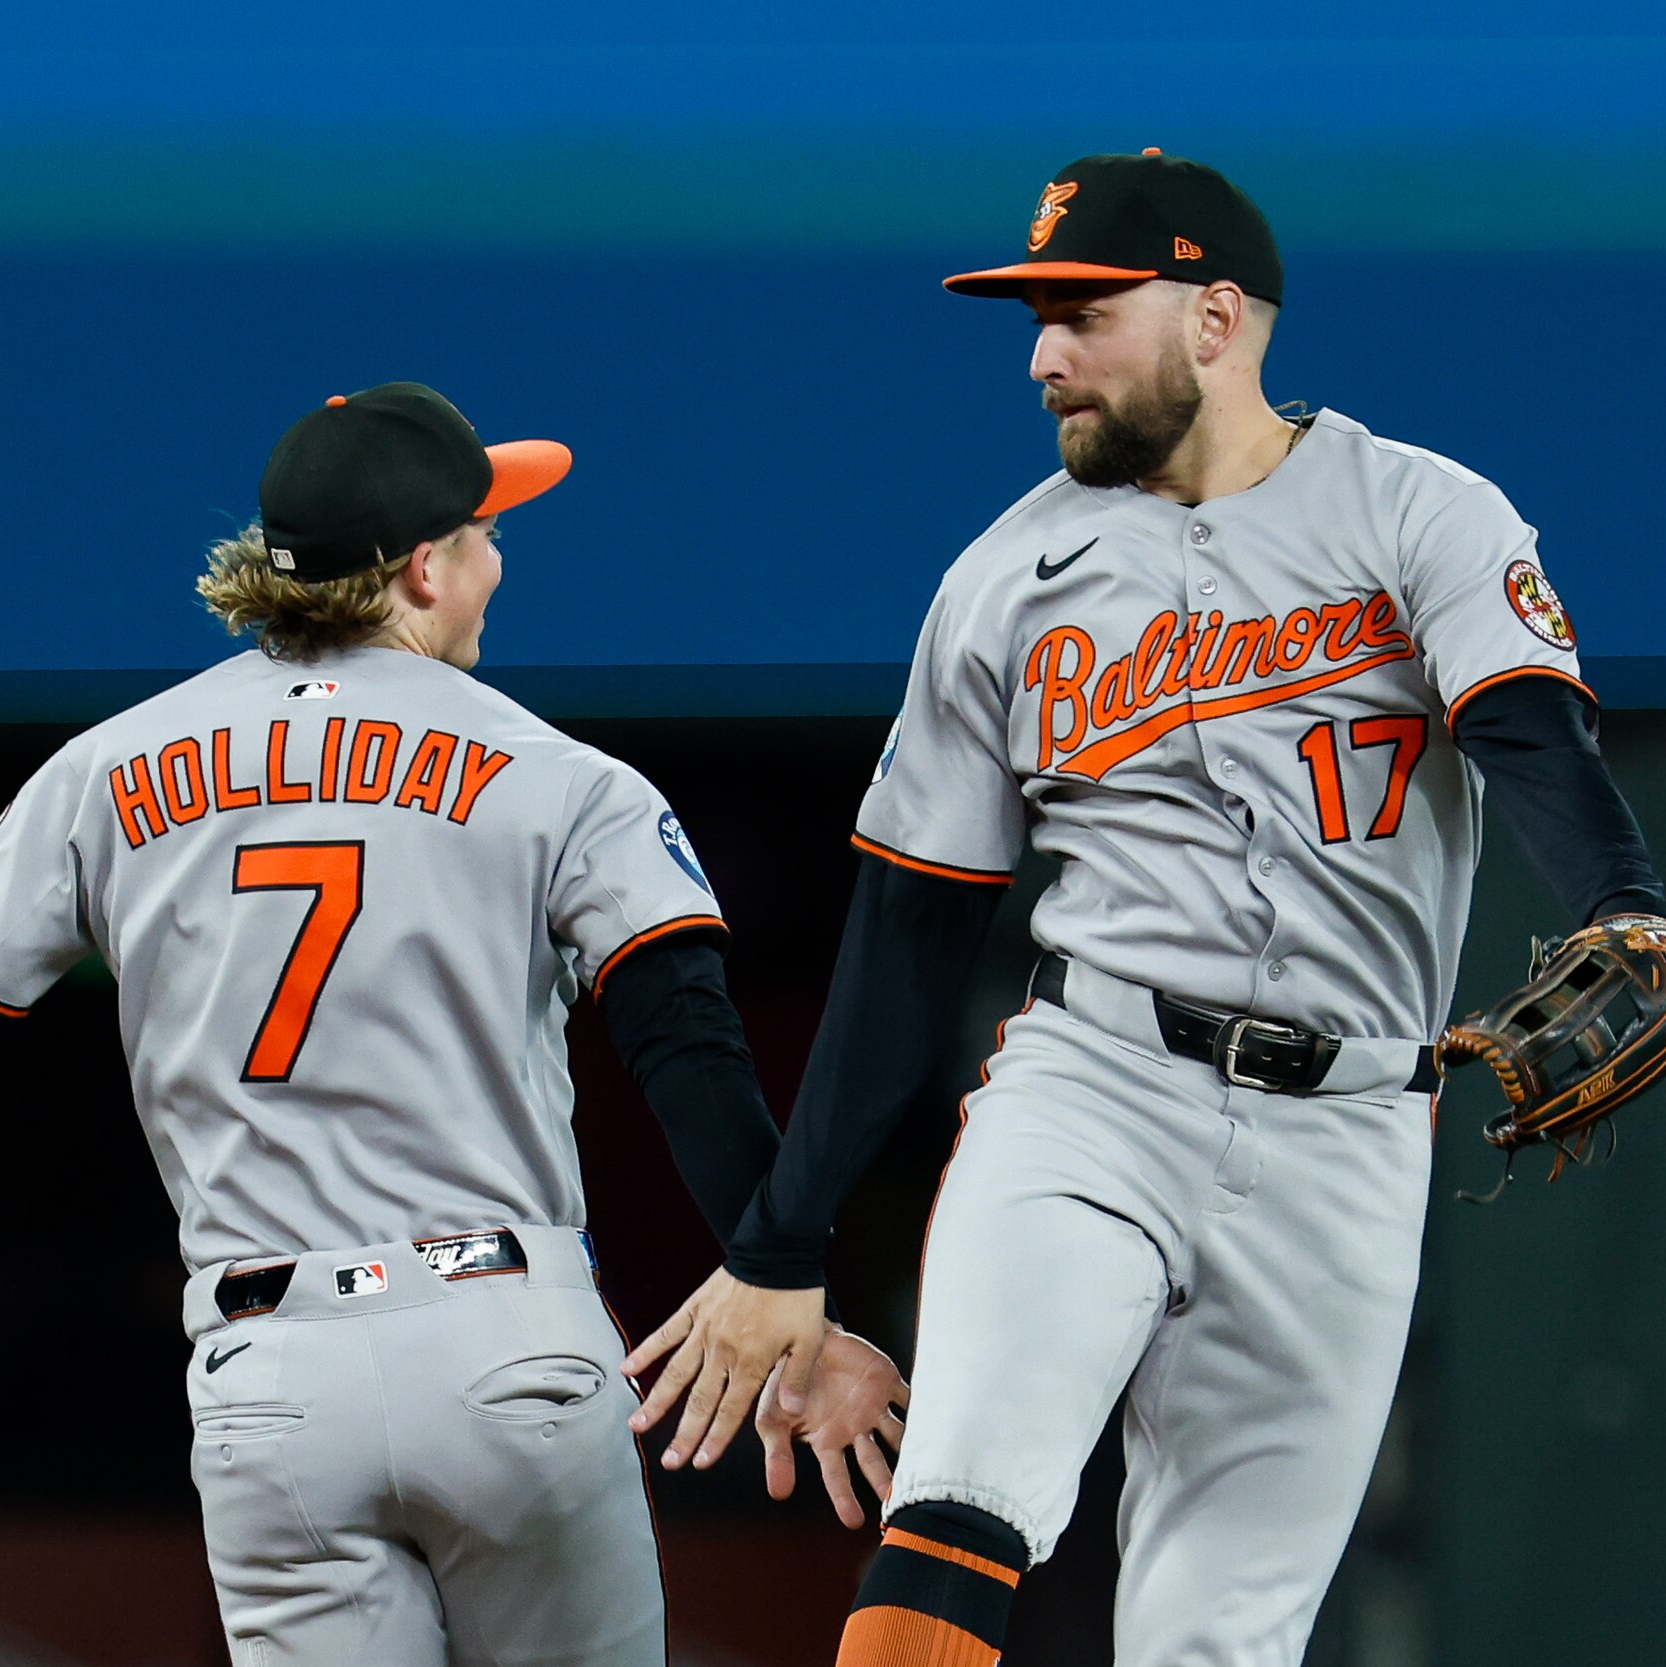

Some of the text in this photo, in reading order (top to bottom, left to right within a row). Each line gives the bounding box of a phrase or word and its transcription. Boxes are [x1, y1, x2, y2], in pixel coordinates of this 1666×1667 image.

[1024, 588, 1415, 782] Baltimore
[107, 716, 514, 850] HOLLIDAY
[1296, 713, 1429, 846] 17
[231, 839, 365, 1083] 7
